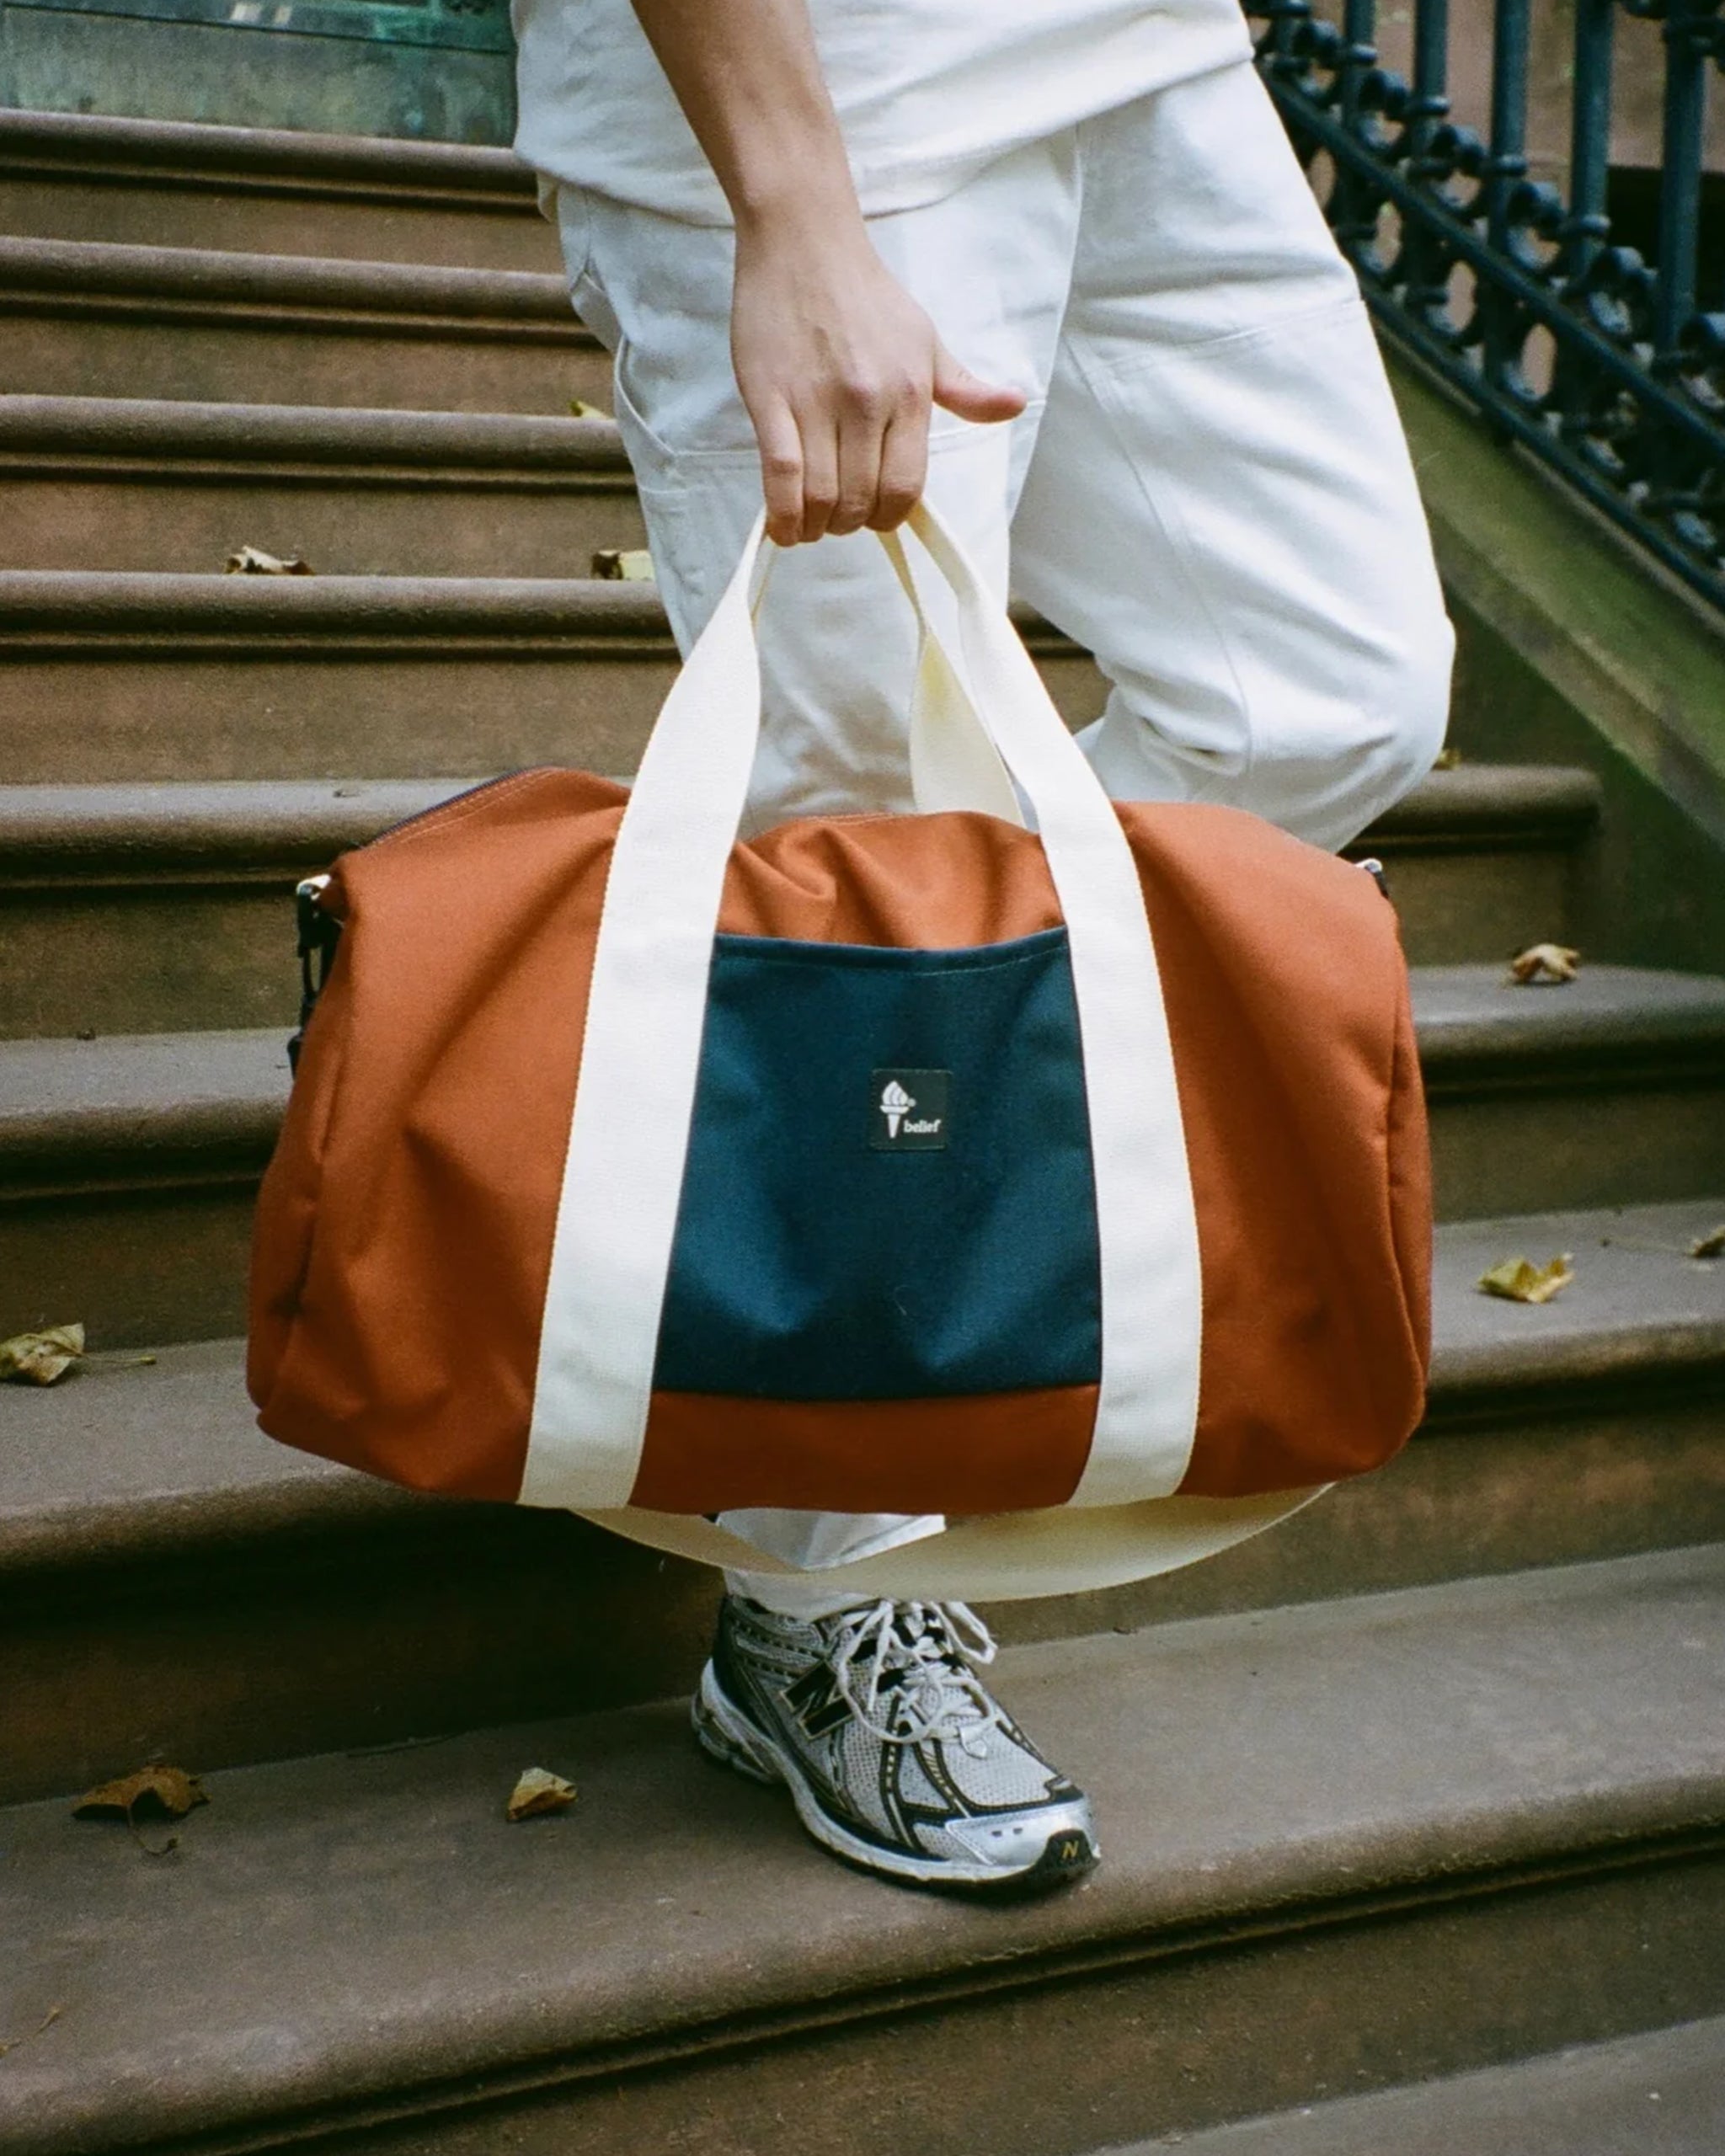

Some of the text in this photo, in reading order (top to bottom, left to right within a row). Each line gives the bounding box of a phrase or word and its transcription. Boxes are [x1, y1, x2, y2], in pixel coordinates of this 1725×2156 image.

[904, 1118, 942, 1134] belief
[779, 1660, 853, 1742] N
[1062, 1839, 1079, 1860] N
